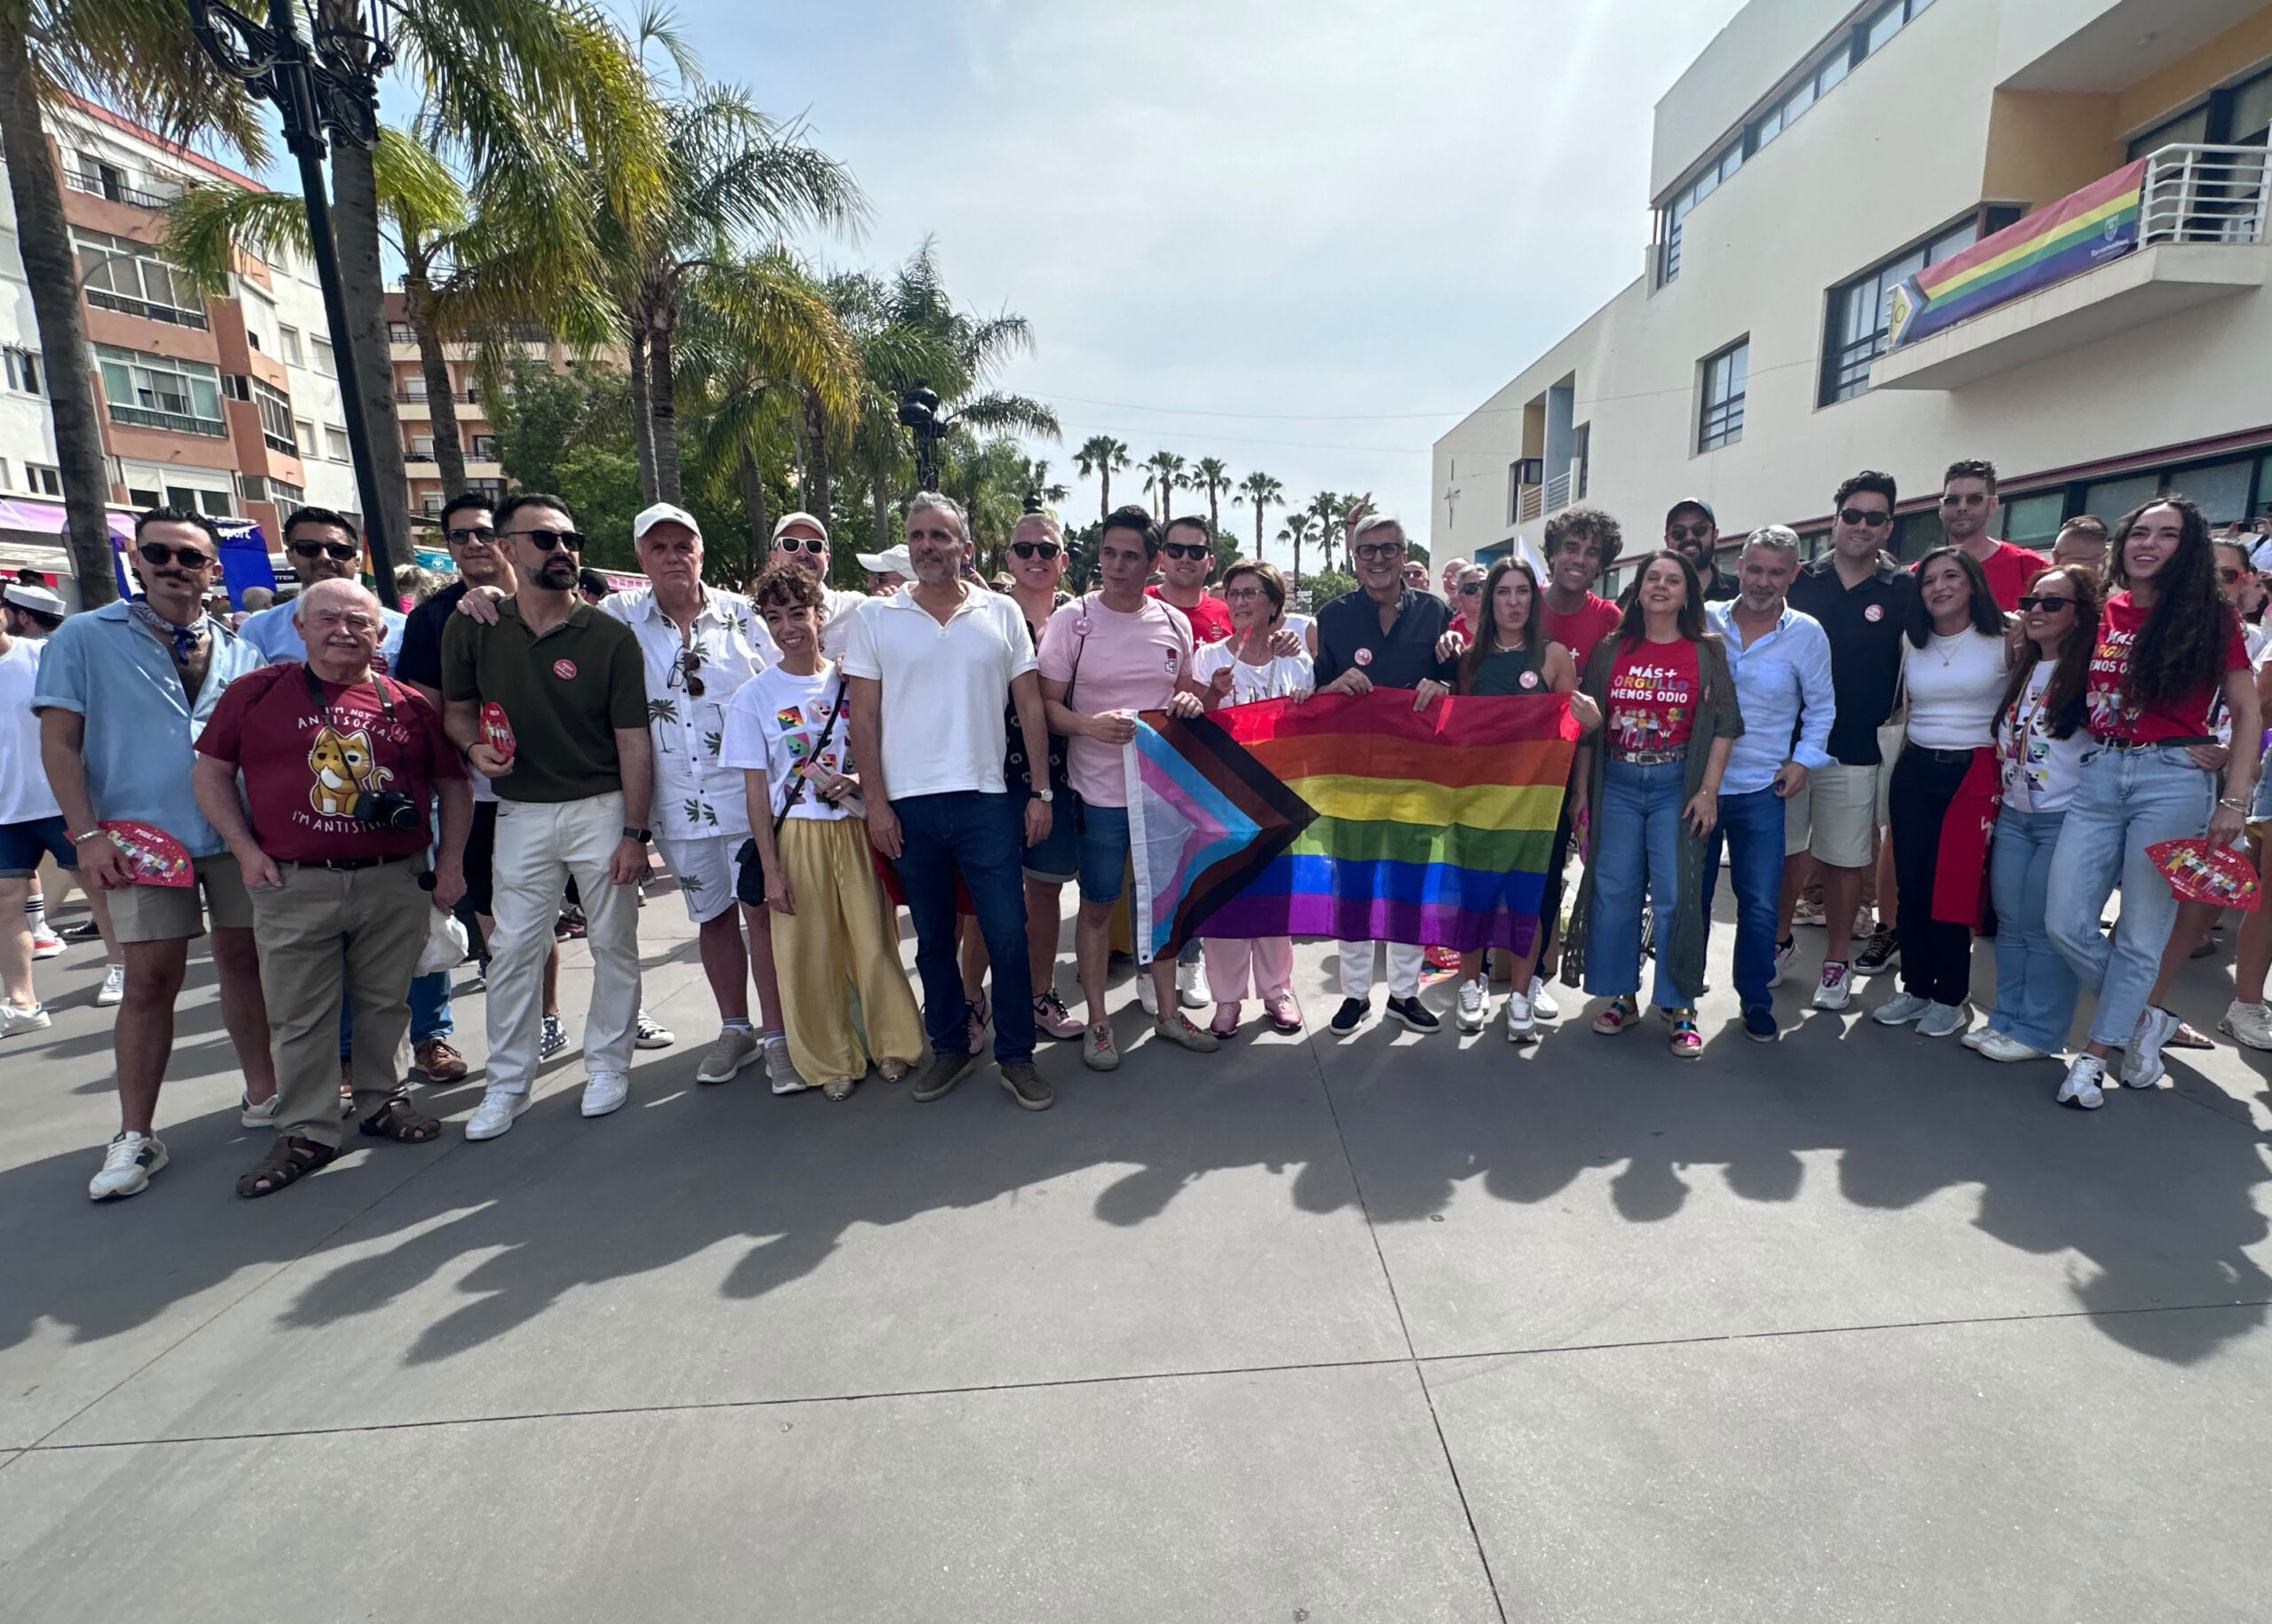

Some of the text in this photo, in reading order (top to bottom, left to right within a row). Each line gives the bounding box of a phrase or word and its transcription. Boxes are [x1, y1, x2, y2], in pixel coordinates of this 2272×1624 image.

[2089, 659, 2118, 673] ENOS
[1613, 674, 1688, 690] ORGULLO
[1610, 689, 1688, 704] MENOS ODIO
[350, 709, 372, 720] NOT
[298, 714, 392, 743] ANTISOCIAL
[292, 810, 310, 825] I'M
